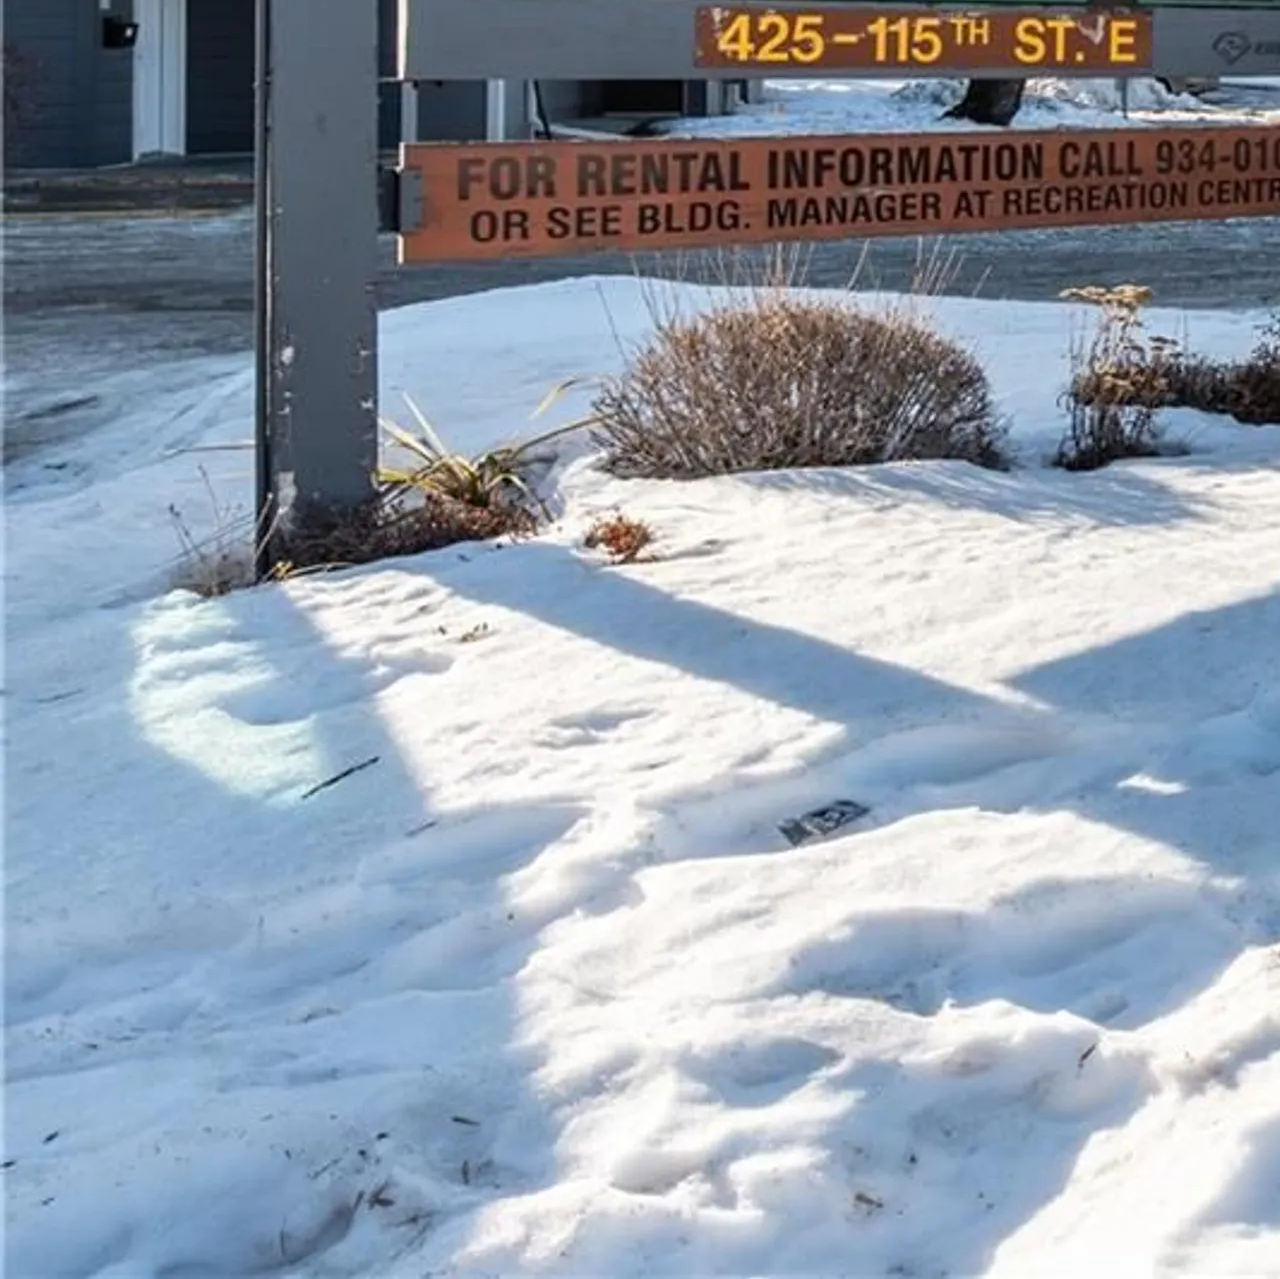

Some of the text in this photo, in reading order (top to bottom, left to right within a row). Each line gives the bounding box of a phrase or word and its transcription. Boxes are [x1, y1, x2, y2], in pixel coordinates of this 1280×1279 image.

[1014, 17, 1085, 63] ST.
[1108, 19, 1137, 62] E
[457, 155, 556, 200] FOR
[576, 149, 750, 195] RENTAL
[767, 139, 1044, 190] INFORMATION
[1058, 140, 1143, 179] CALL
[470, 209, 530, 243] OR
[546, 205, 622, 238] SEE
[637, 199, 752, 235] BLDG.
[766, 192, 941, 230] MANAGER
[953, 189, 994, 219] AT
[1002, 181, 1190, 216] RECREATION
